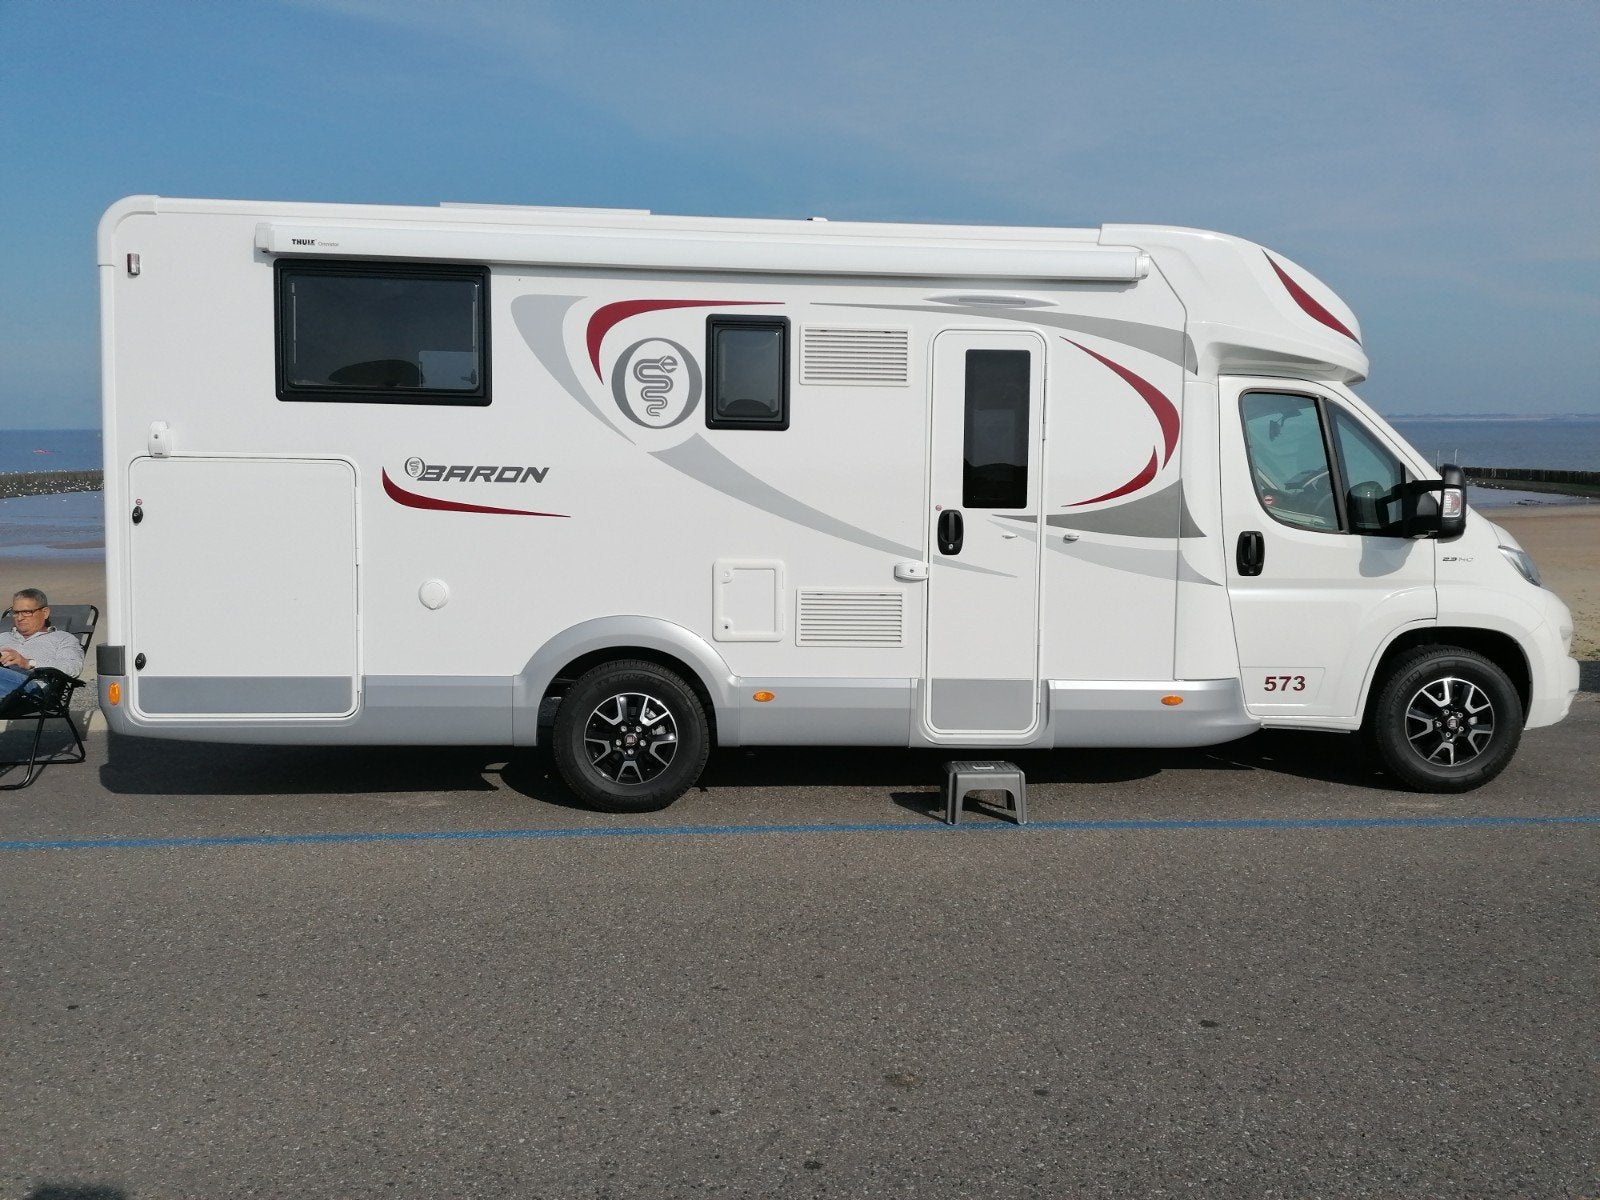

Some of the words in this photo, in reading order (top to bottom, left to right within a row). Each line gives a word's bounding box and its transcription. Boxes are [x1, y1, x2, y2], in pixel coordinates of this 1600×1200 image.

[291, 238, 316, 246] THULE
[416, 464, 550, 484] BARON
[1263, 675, 1306, 692] 573
